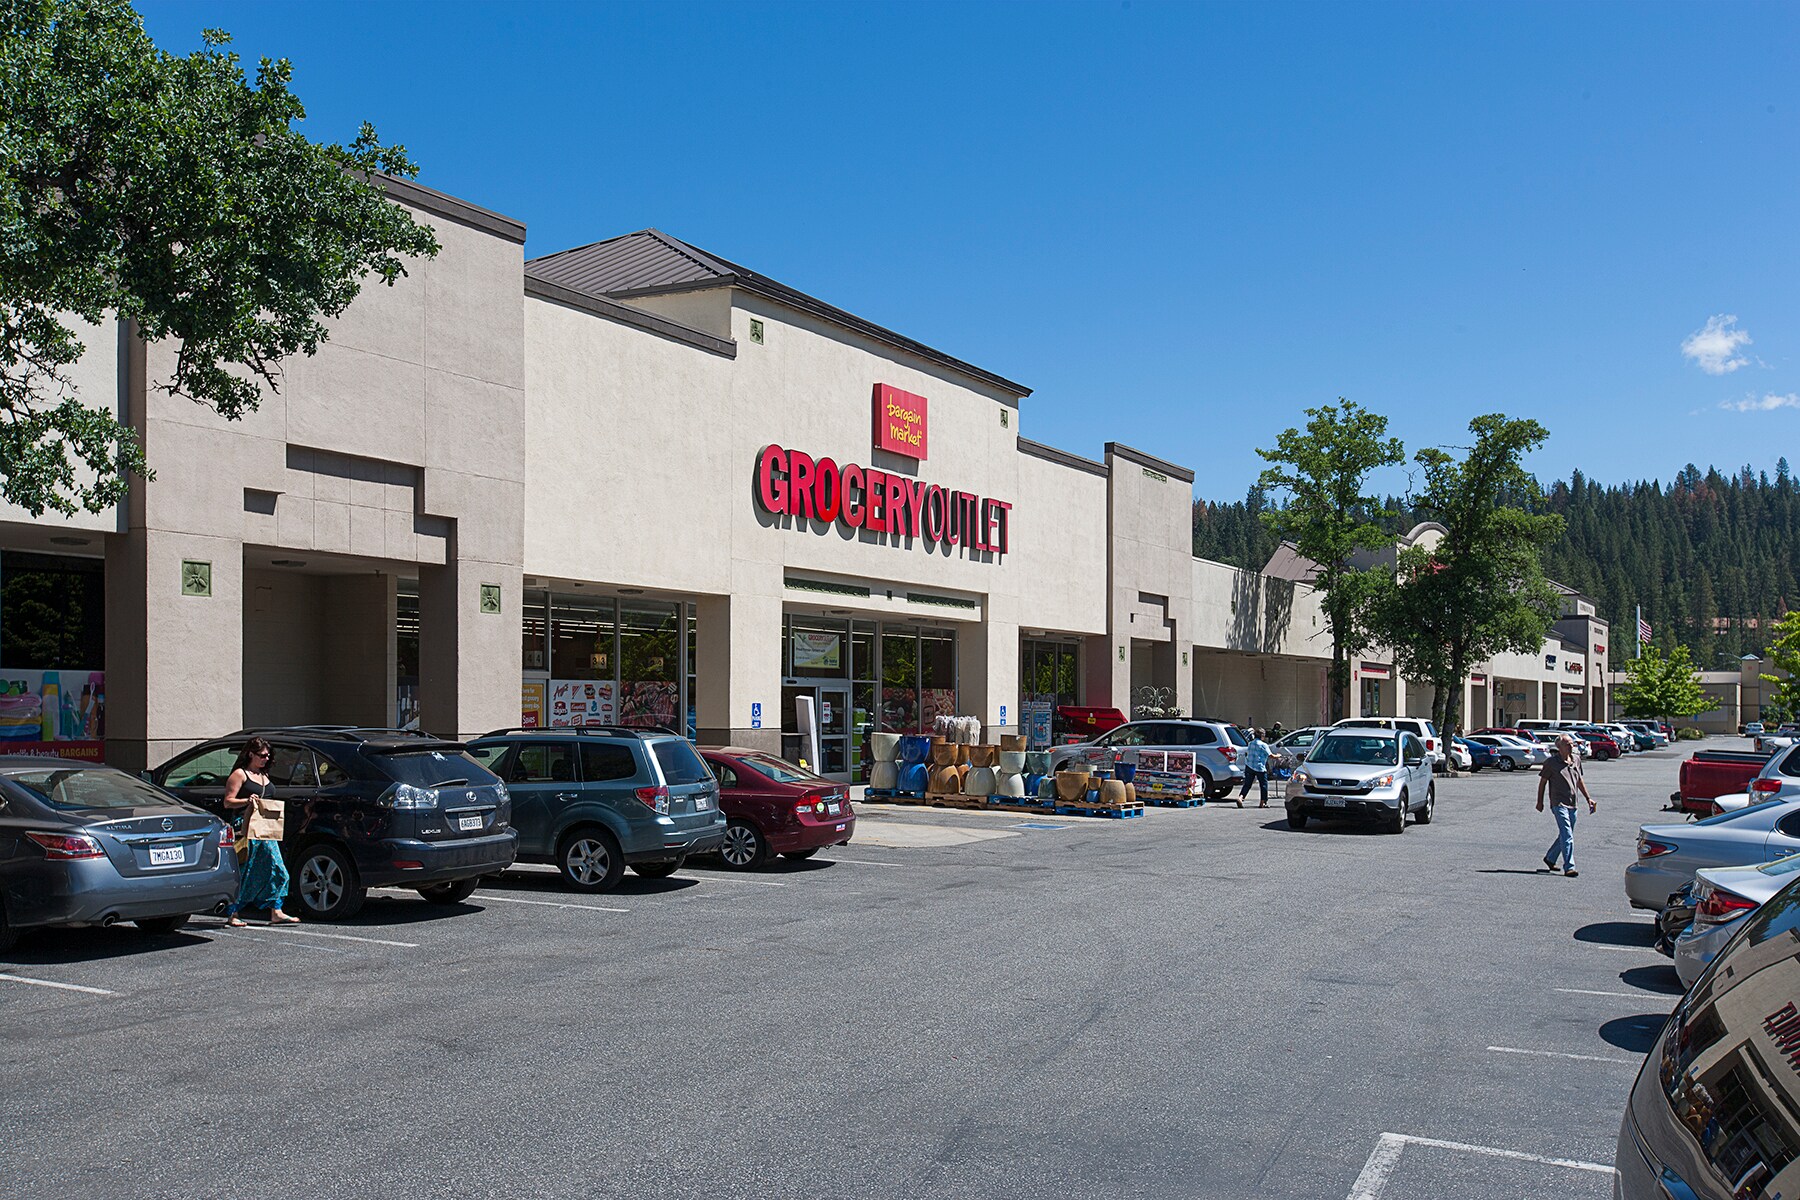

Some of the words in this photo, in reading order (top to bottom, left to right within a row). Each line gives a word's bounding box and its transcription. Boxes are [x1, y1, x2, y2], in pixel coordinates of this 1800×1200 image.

[887, 394, 921, 428] bargain
[890, 423, 922, 447] market
[756, 443, 926, 538] GROCERY
[924, 484, 1012, 554] OUTLET
[30, 748, 36, 757] &
[60, 748, 98, 757] BARGAINS
[152, 849, 183, 862] 7MGA130
